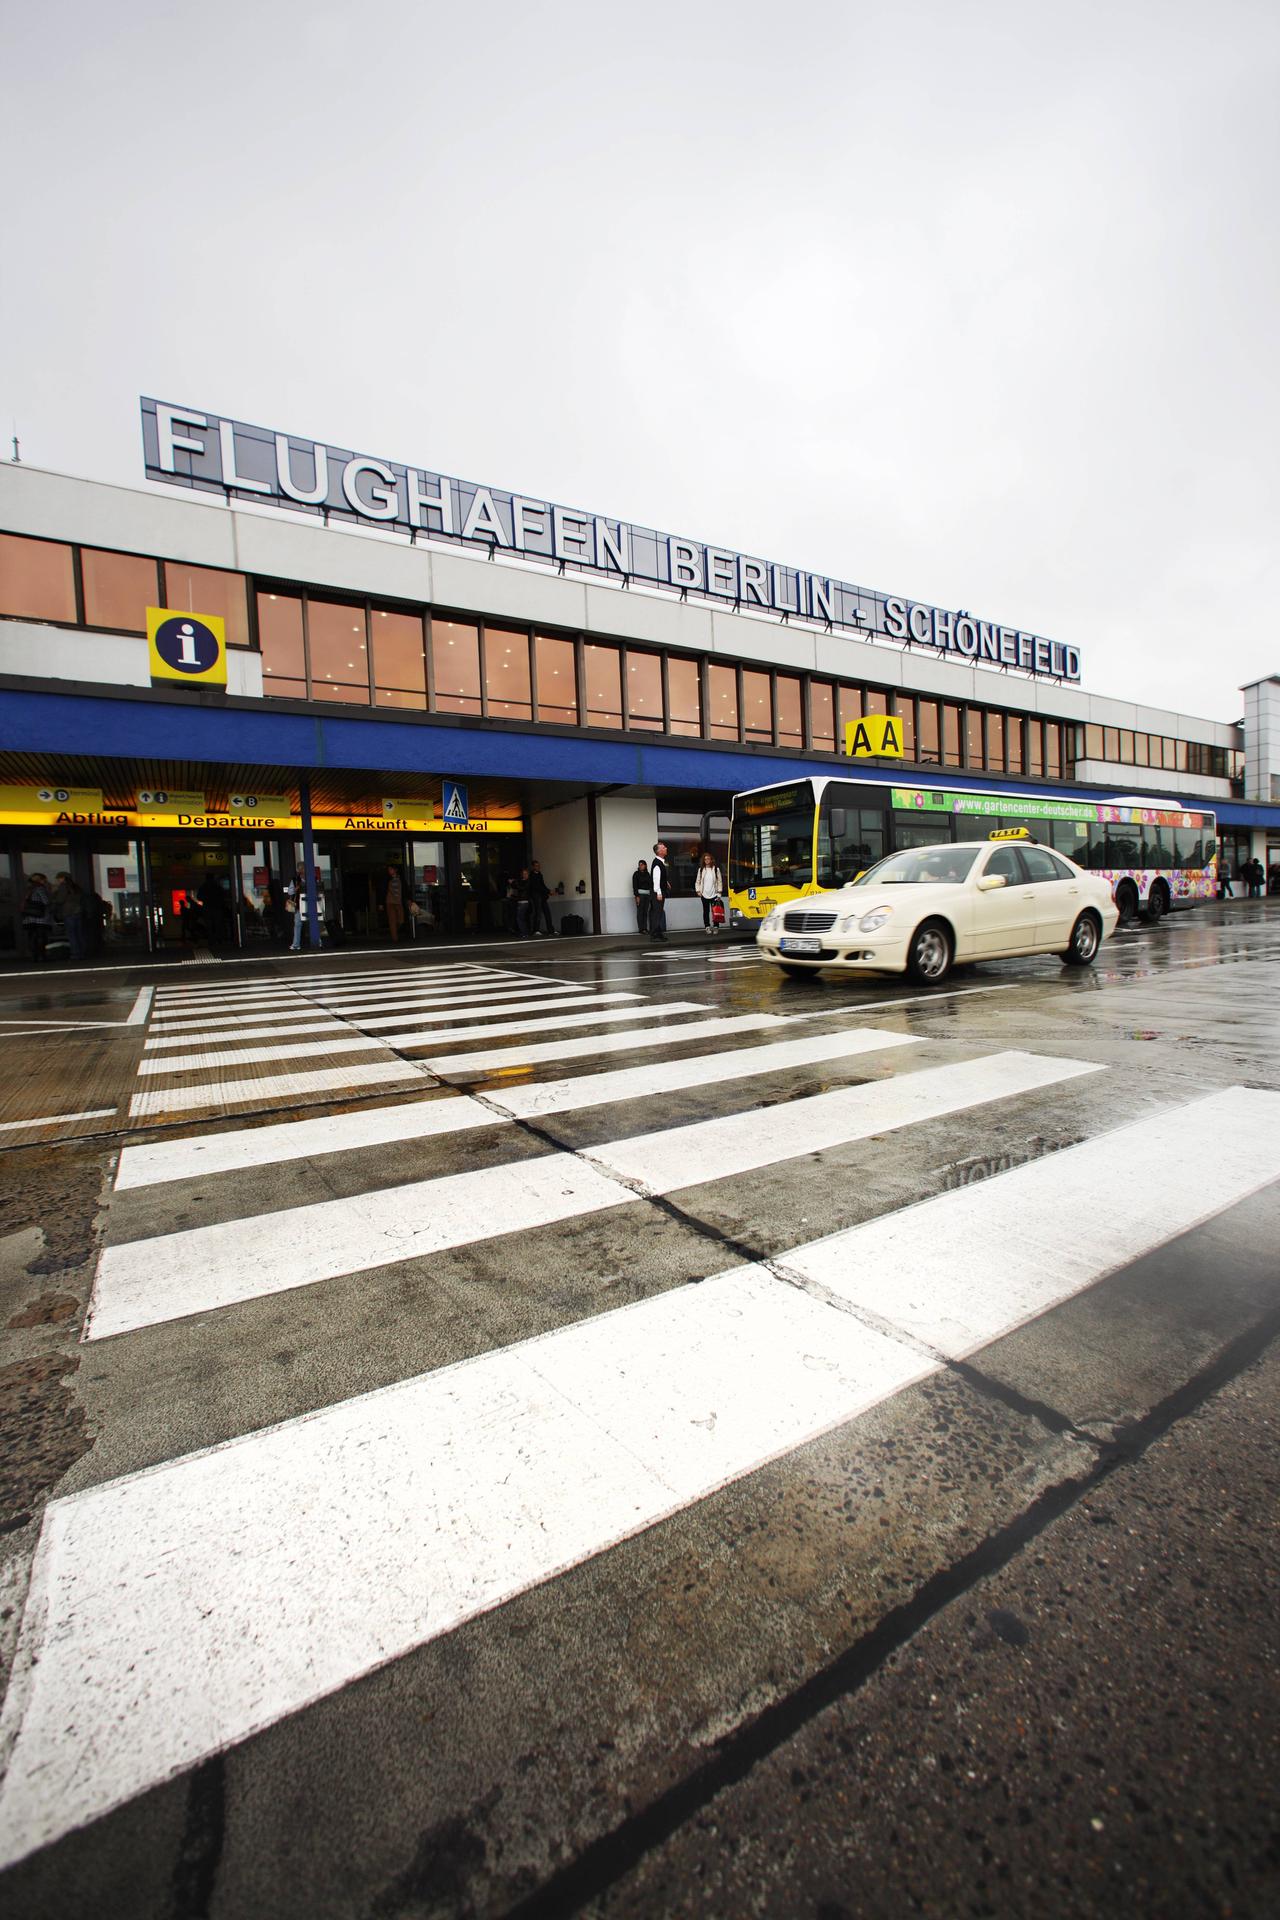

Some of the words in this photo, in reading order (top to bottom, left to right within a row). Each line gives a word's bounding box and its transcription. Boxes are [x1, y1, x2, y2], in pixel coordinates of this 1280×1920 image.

[156, 403, 629, 574] FLUGHAFEN
[667, 537, 835, 622] BERLIN
[884, 597, 1081, 679] SCHÖNEFELD
[851, 723, 872, 755] A
[881, 720, 899, 752] A
[248, 797, 256, 806] B
[56, 812, 128, 826] Abflug
[178, 814, 275, 828] Departure
[344, 818, 408, 830] Ankunft
